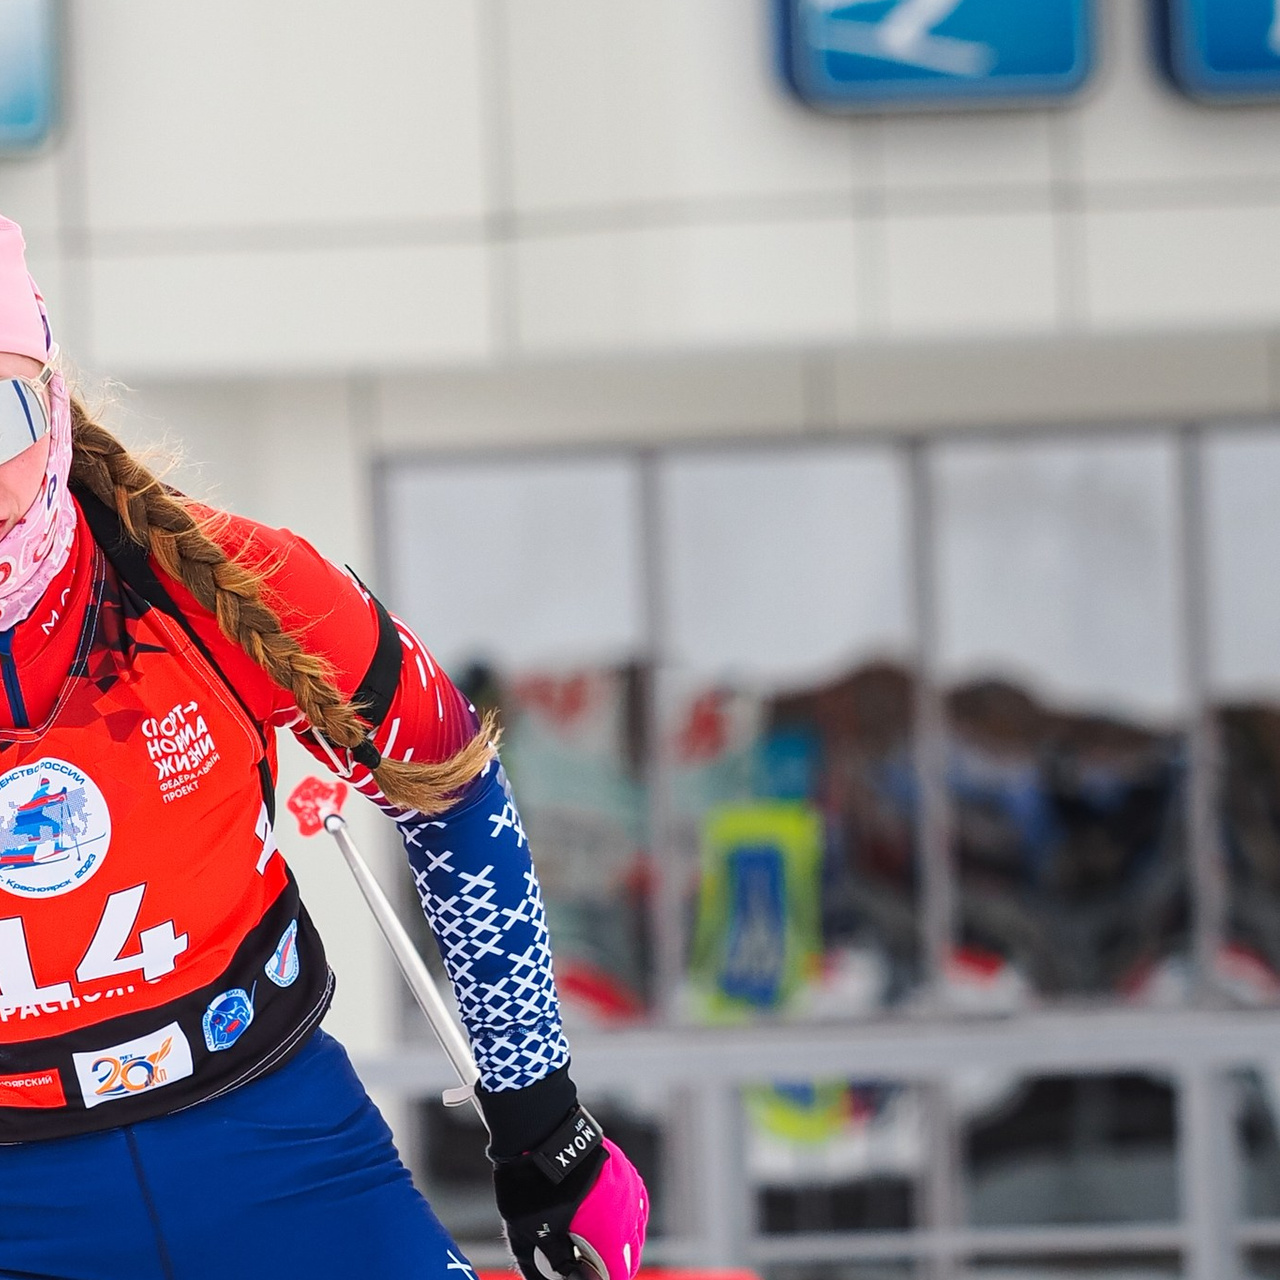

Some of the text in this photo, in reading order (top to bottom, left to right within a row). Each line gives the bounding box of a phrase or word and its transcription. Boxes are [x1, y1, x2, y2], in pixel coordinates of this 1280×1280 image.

[40, 761, 86, 786] РОССИИ
[162, 780, 200, 804] ПРОЕКТ
[6, 878, 73, 893] Красноярск
[74, 853, 97, 879] 2023
[91, 1055, 157, 1096] 20
[555, 1125, 597, 1168] MOAX
